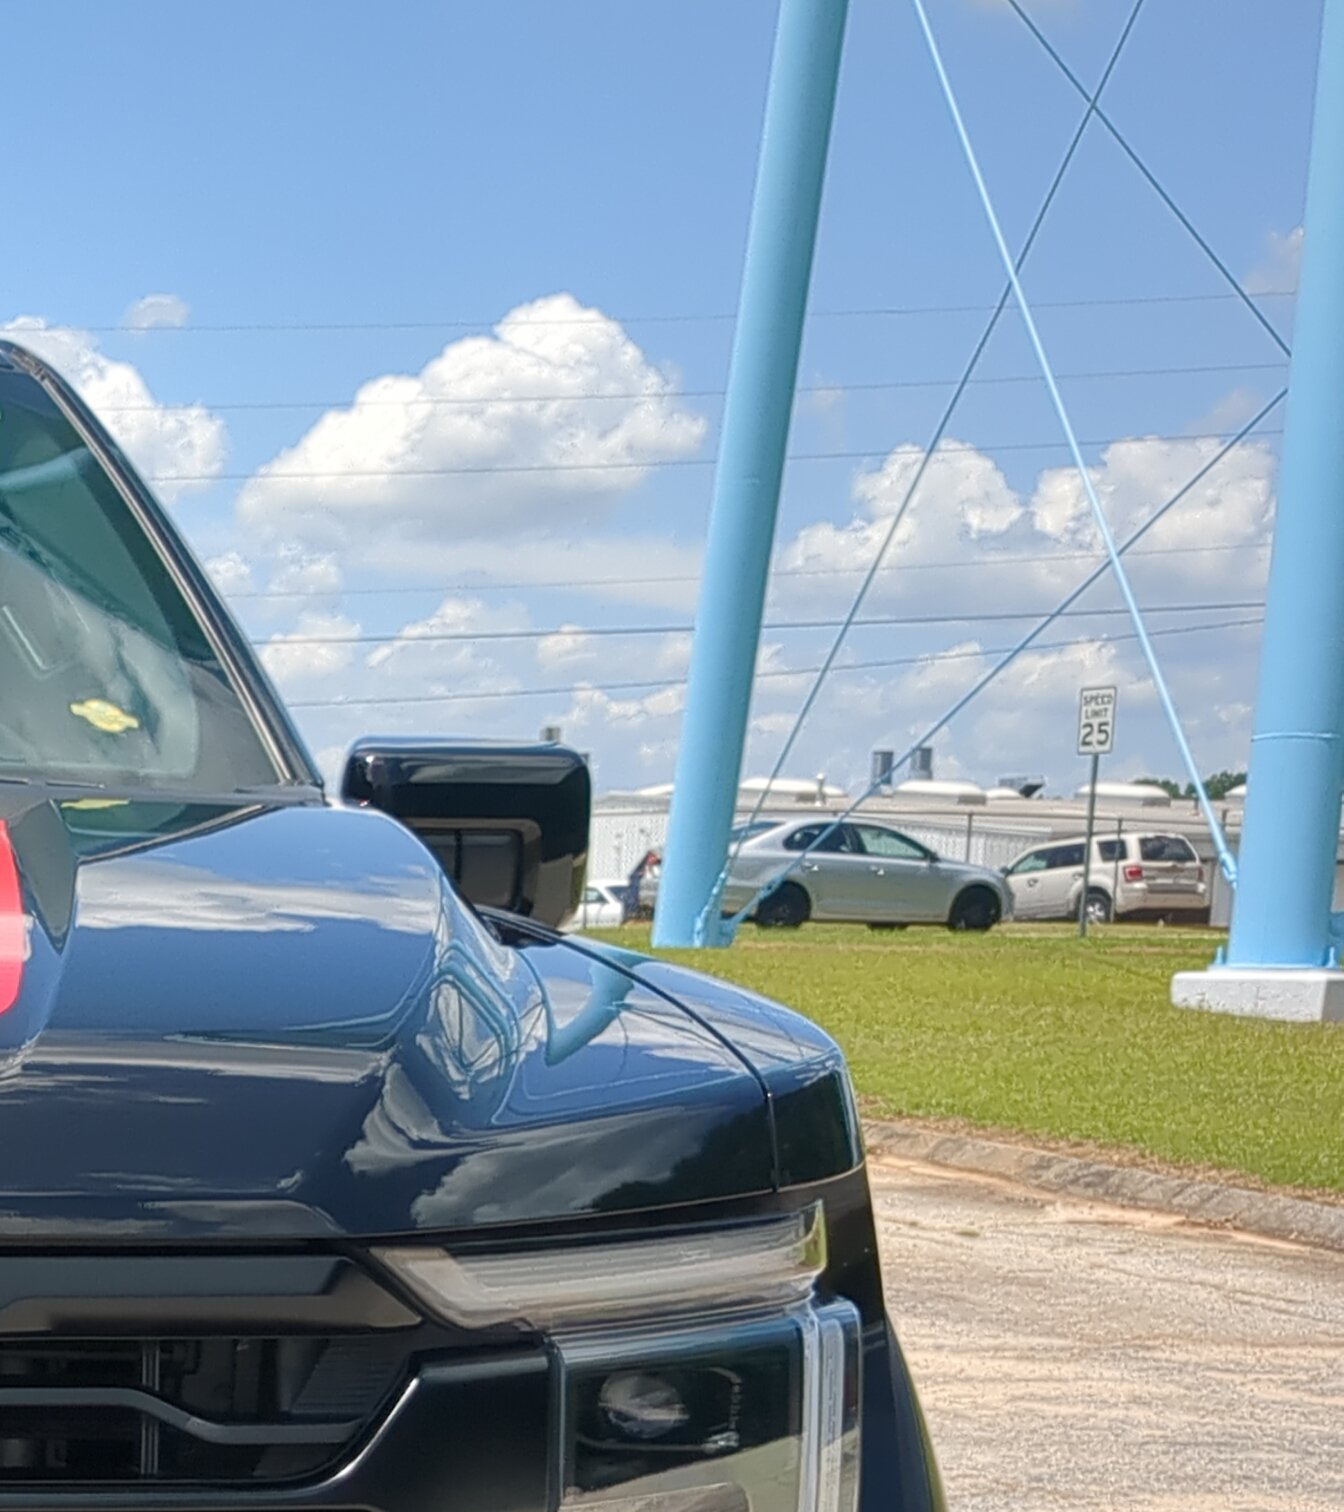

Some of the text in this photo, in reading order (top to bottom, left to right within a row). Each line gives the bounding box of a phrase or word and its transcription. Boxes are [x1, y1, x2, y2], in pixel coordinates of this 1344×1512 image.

[1083, 692, 1113, 706] SPEED
[1084, 707, 1109, 720] LIMIT
[1080, 721, 1110, 747] 25
